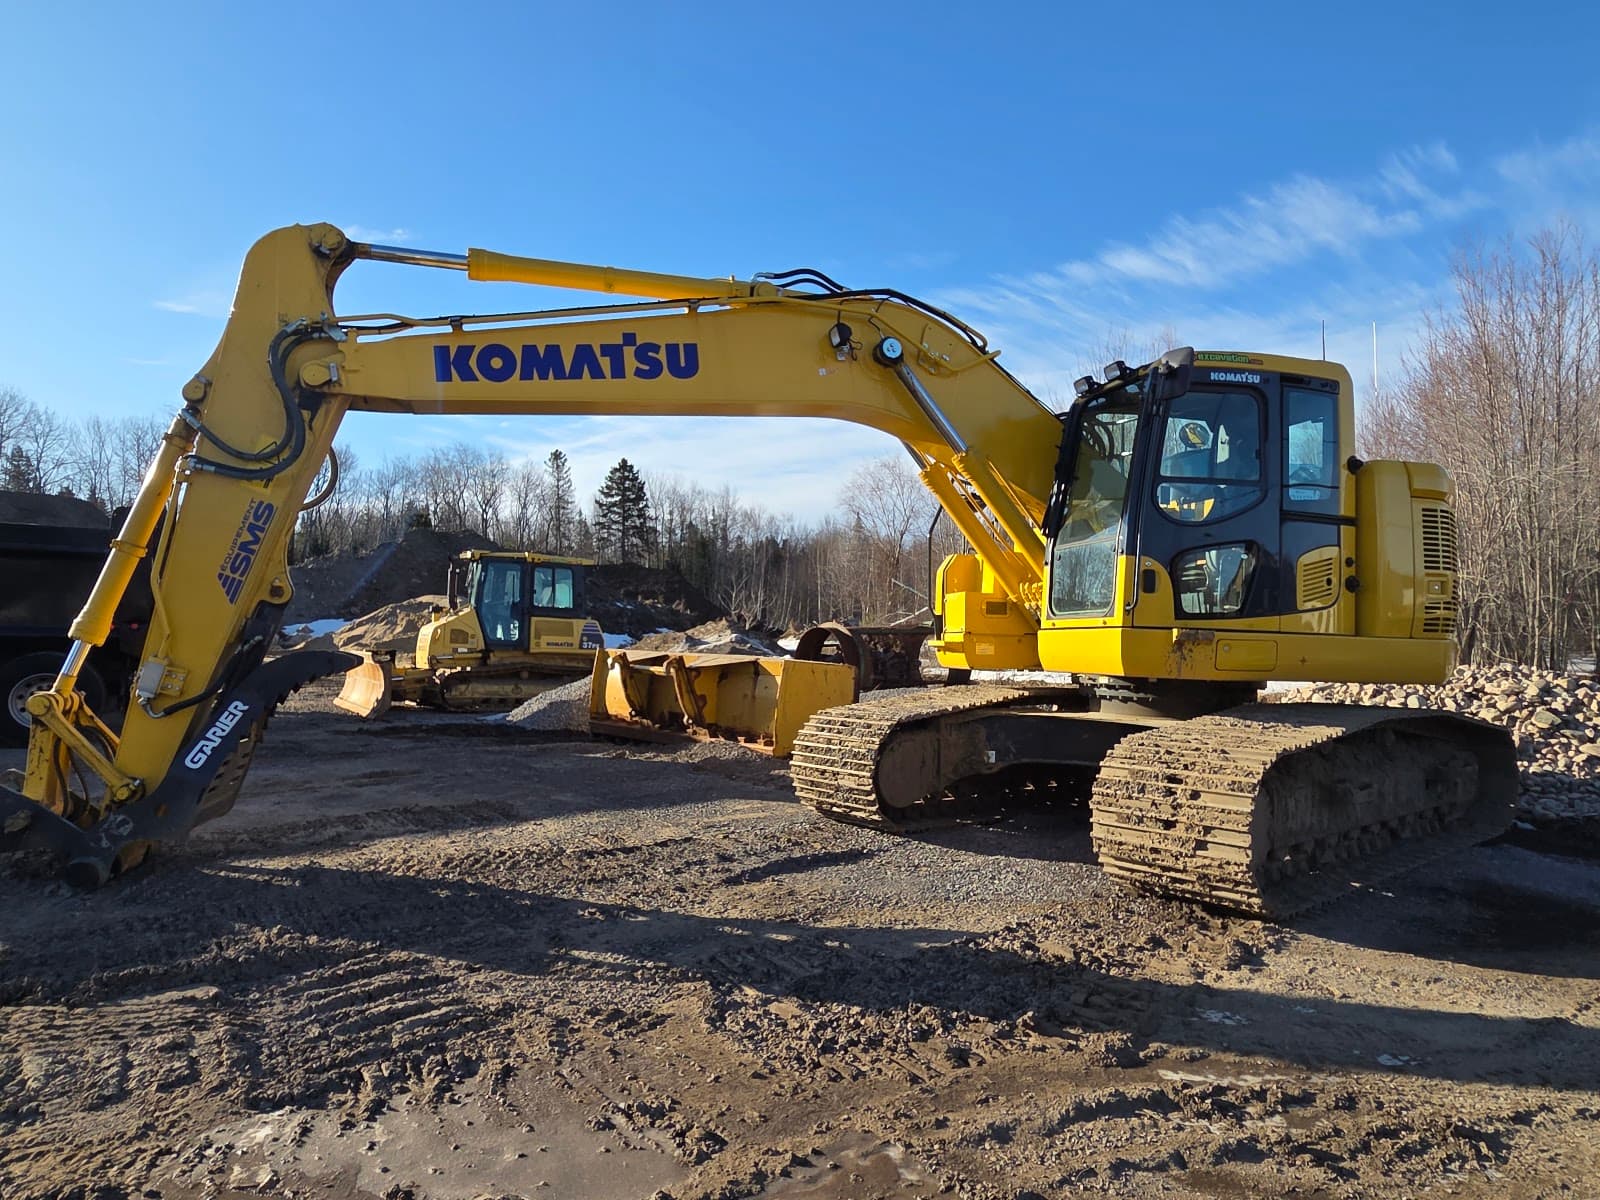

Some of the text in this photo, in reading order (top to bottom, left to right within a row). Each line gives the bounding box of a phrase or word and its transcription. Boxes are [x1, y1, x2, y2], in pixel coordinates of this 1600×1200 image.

[433, 332, 700, 383] KOMATSU
[1210, 372, 1261, 384] KOMATSU
[229, 500, 274, 578] SMS
[184, 700, 249, 769] GARIER
